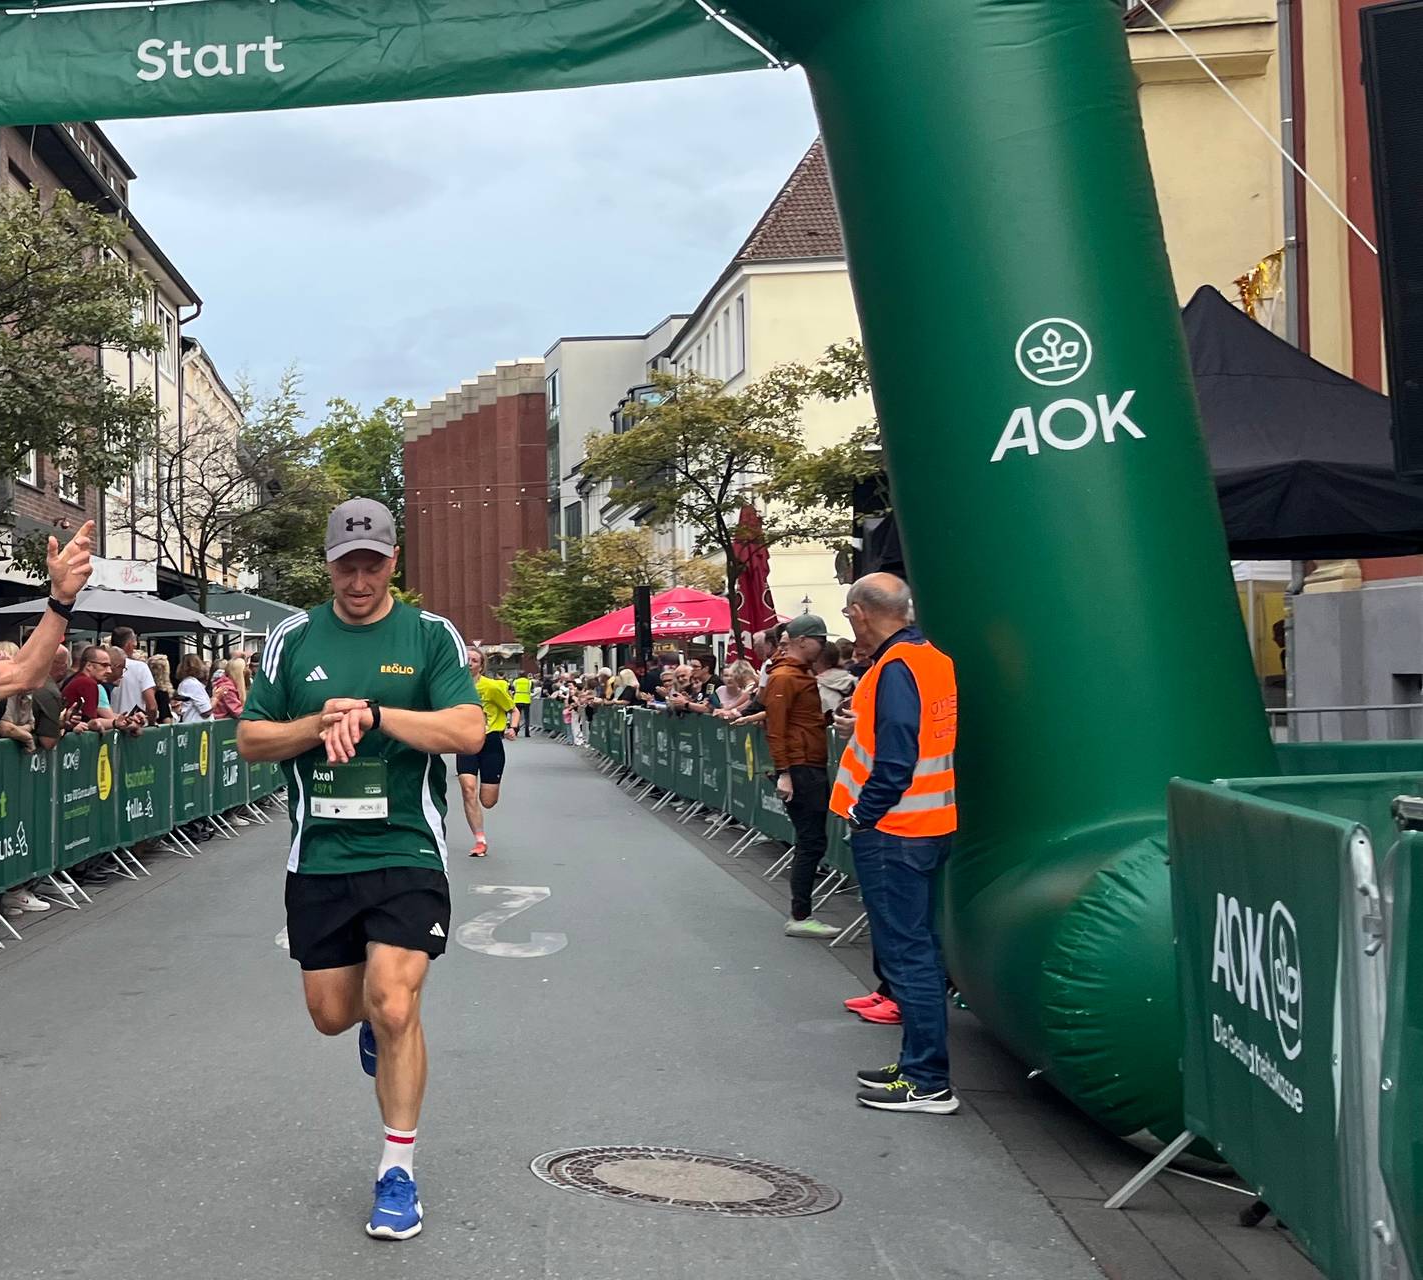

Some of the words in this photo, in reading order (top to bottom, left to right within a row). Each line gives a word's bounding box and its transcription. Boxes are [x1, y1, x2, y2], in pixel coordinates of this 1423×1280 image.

[136, 35, 285, 82] Start
[990, 390, 1147, 463] AOK
[312, 769, 334, 782] Axel
[1211, 892, 1273, 1021] AOK
